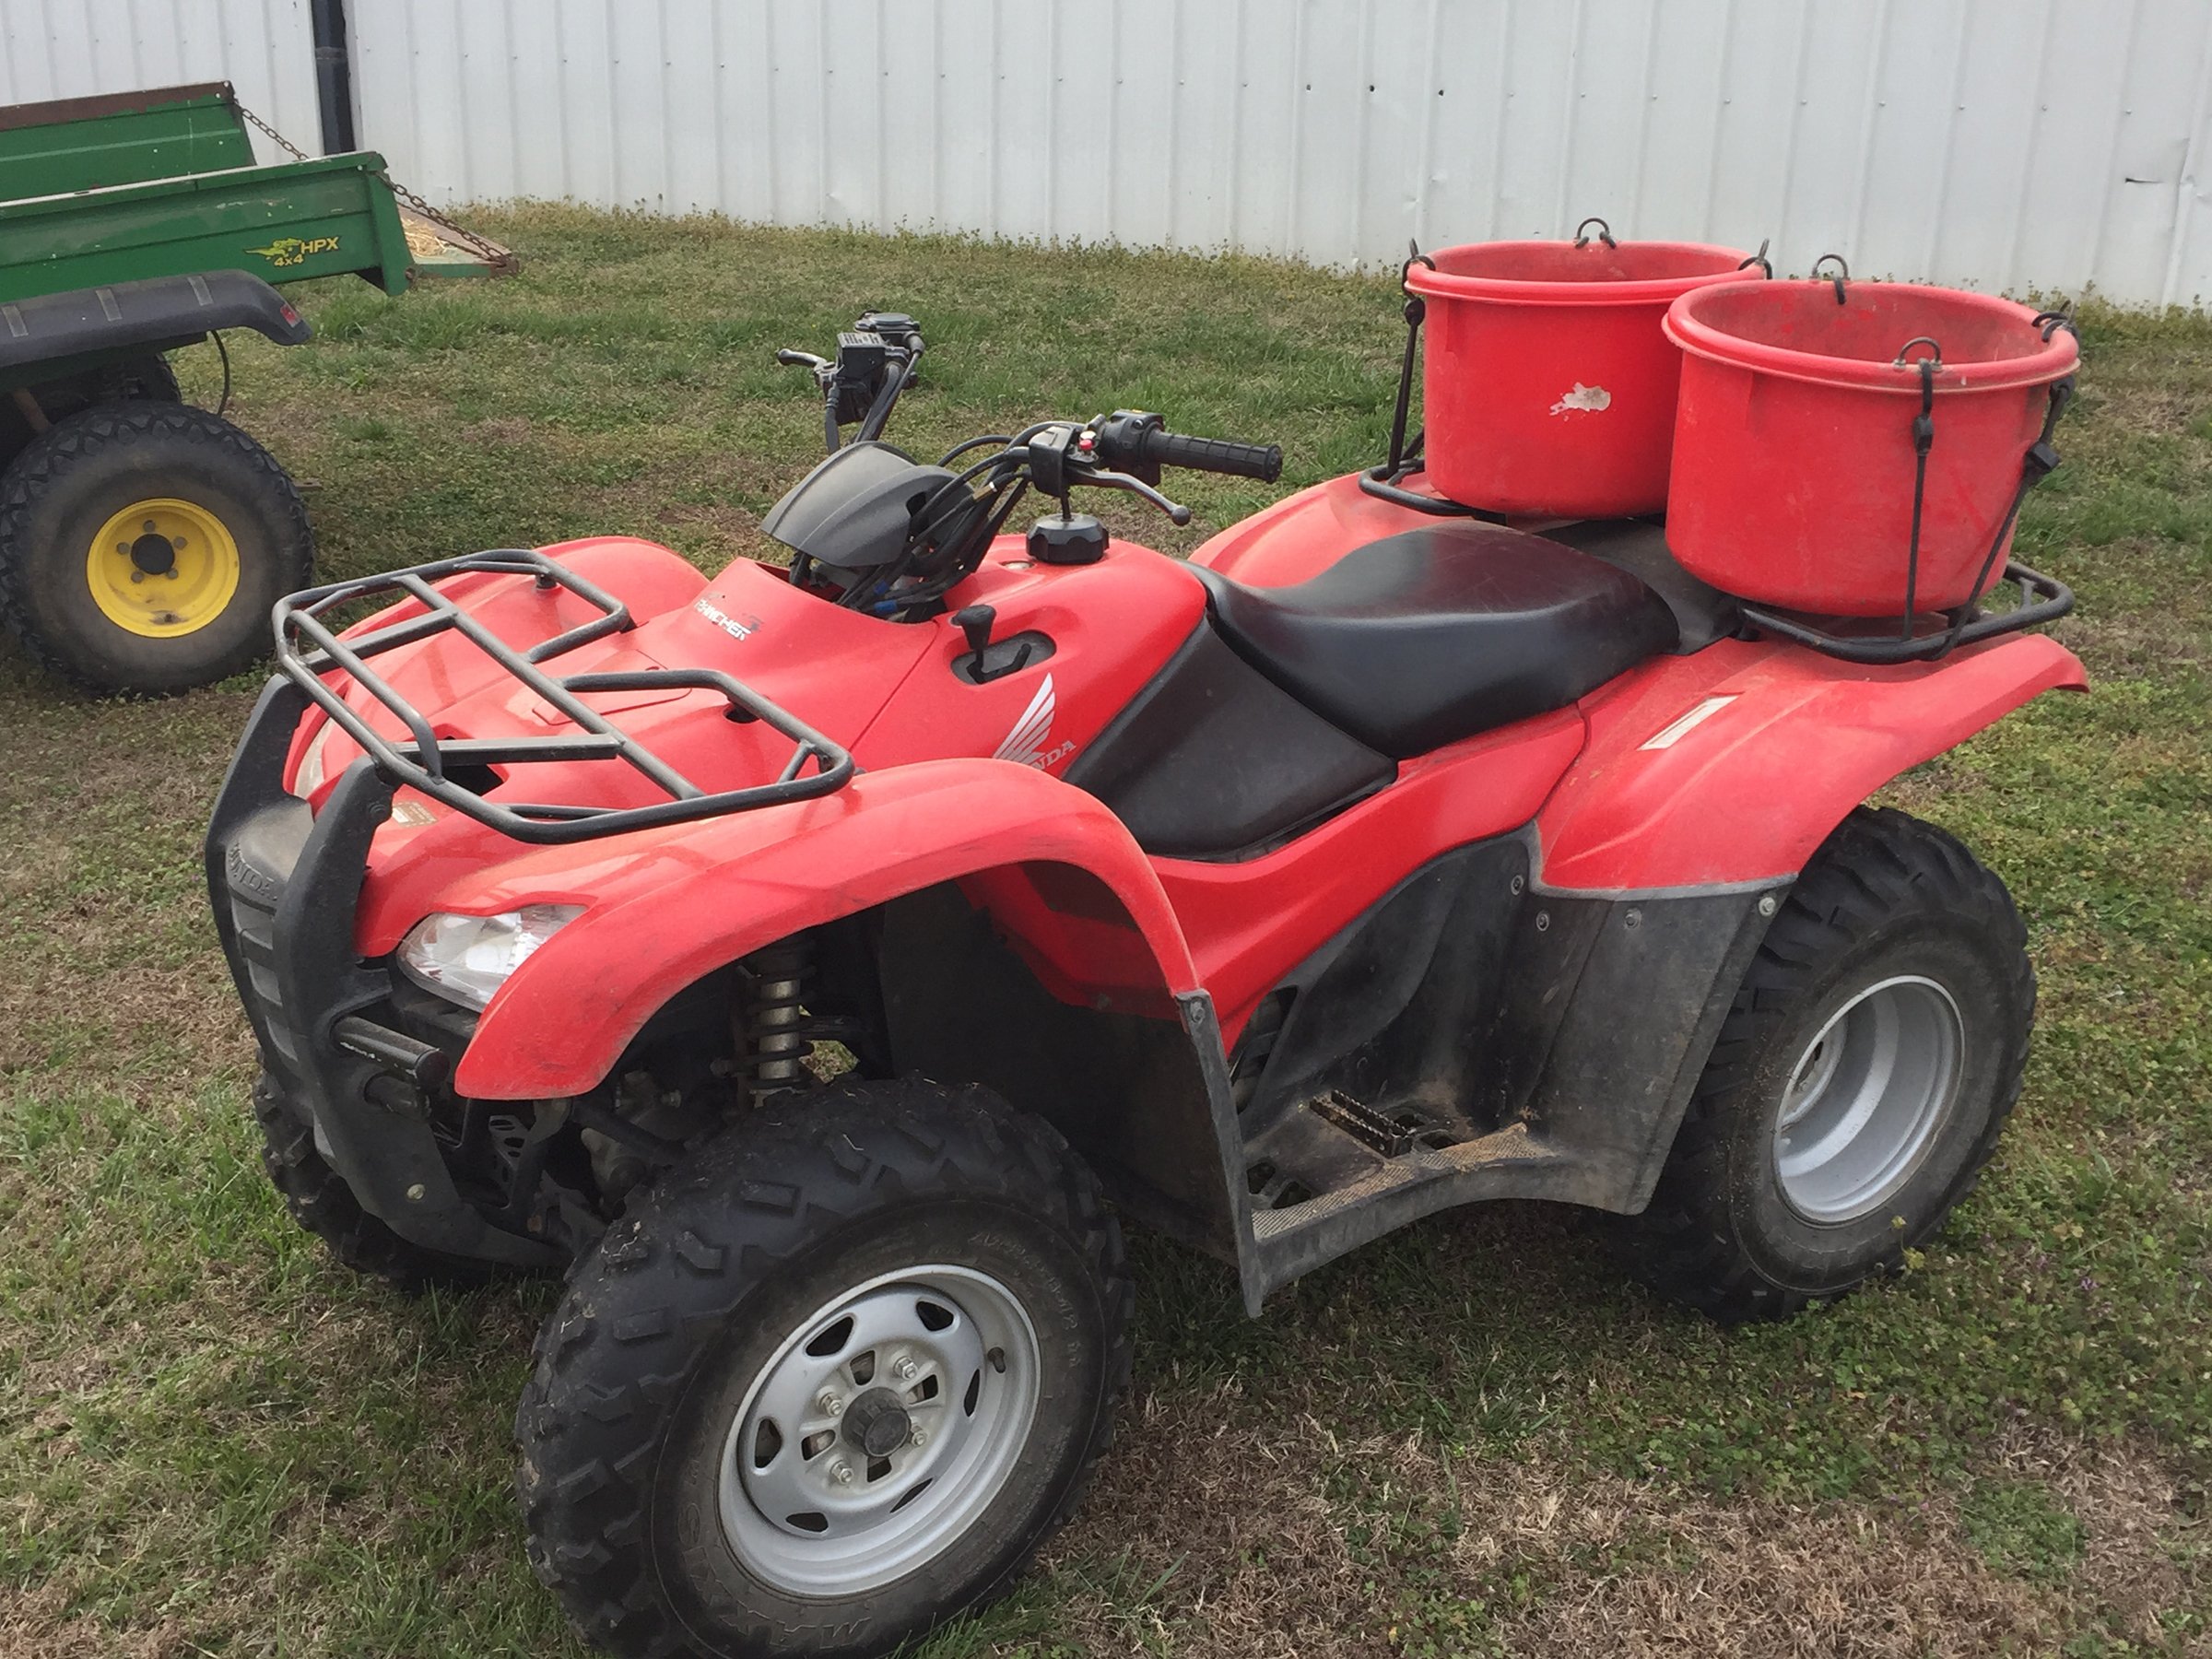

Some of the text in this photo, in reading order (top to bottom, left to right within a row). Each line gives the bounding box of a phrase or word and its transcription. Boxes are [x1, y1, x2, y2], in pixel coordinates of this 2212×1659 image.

[300, 236, 339, 254] HPX
[273, 253, 304, 266] 4x4
[1031, 739, 1077, 771] NDA
